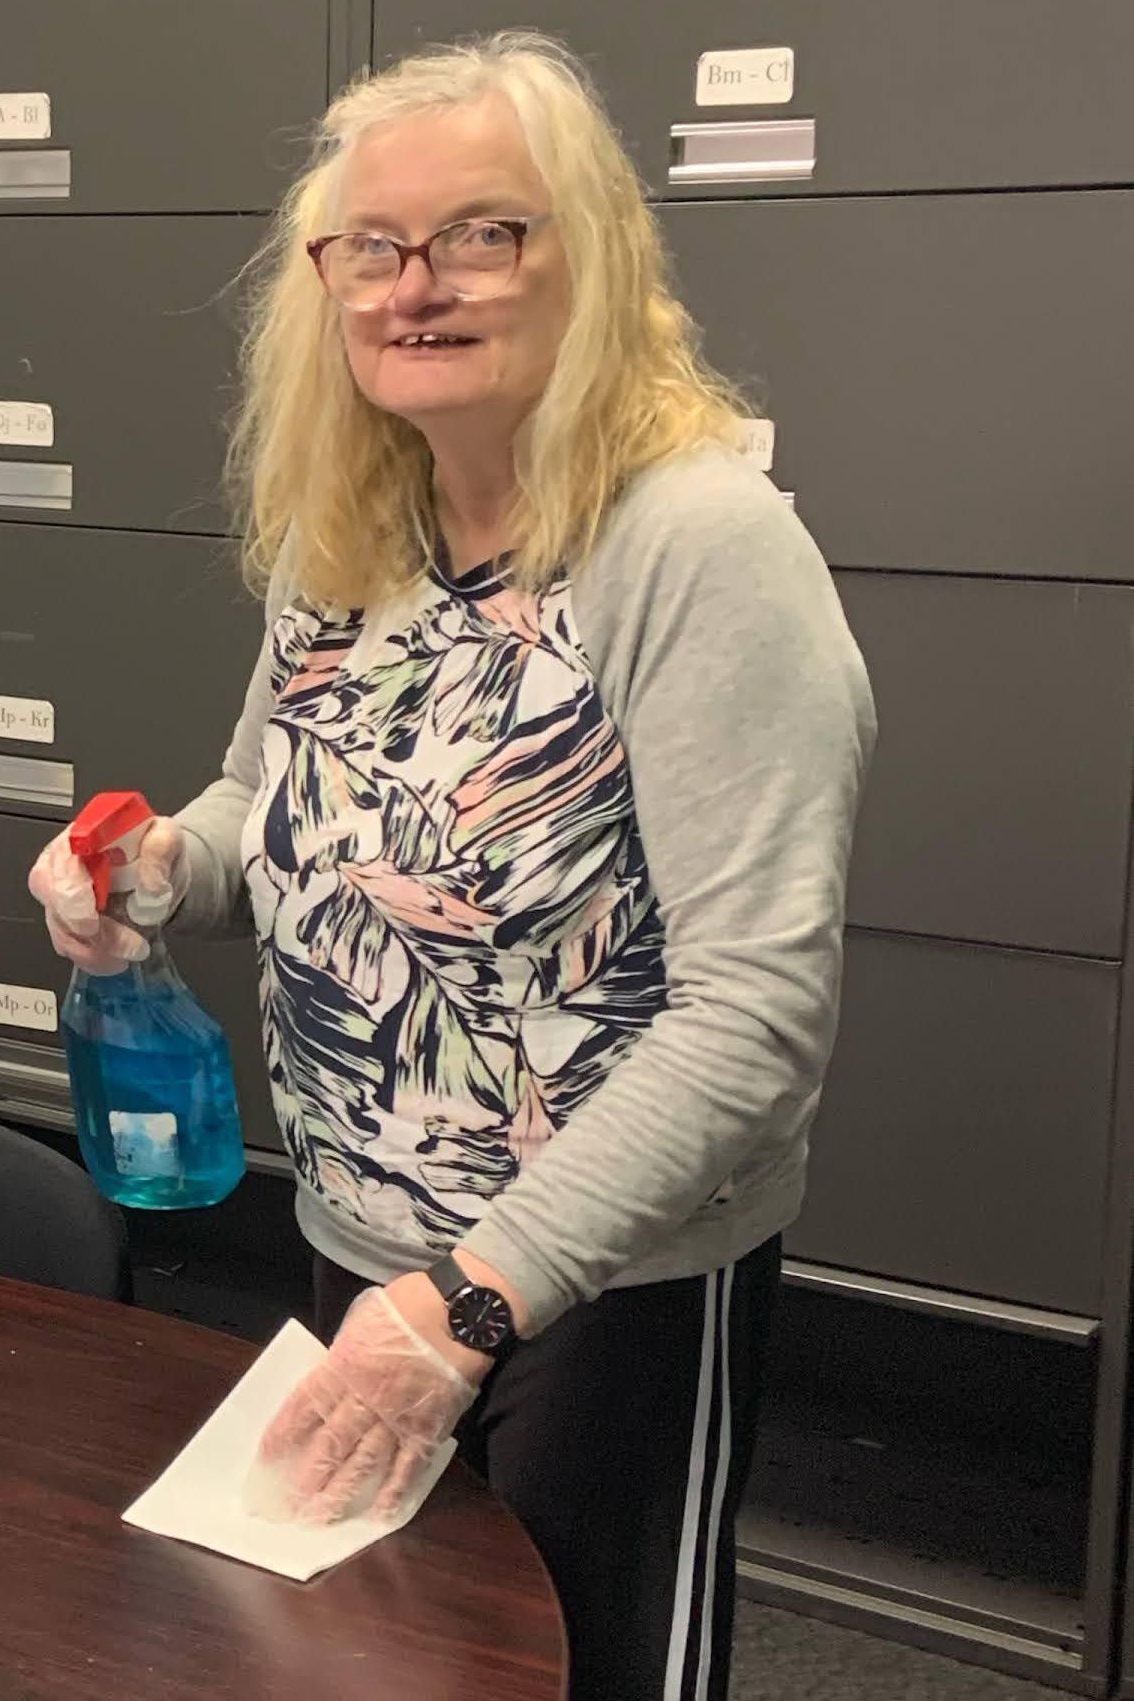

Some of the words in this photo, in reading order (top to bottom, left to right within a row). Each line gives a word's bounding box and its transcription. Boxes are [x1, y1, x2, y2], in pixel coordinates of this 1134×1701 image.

[707, 64, 742, 85] Bm
[31, 710, 50, 728] Kr
[33, 999, 54, 1016] Or
